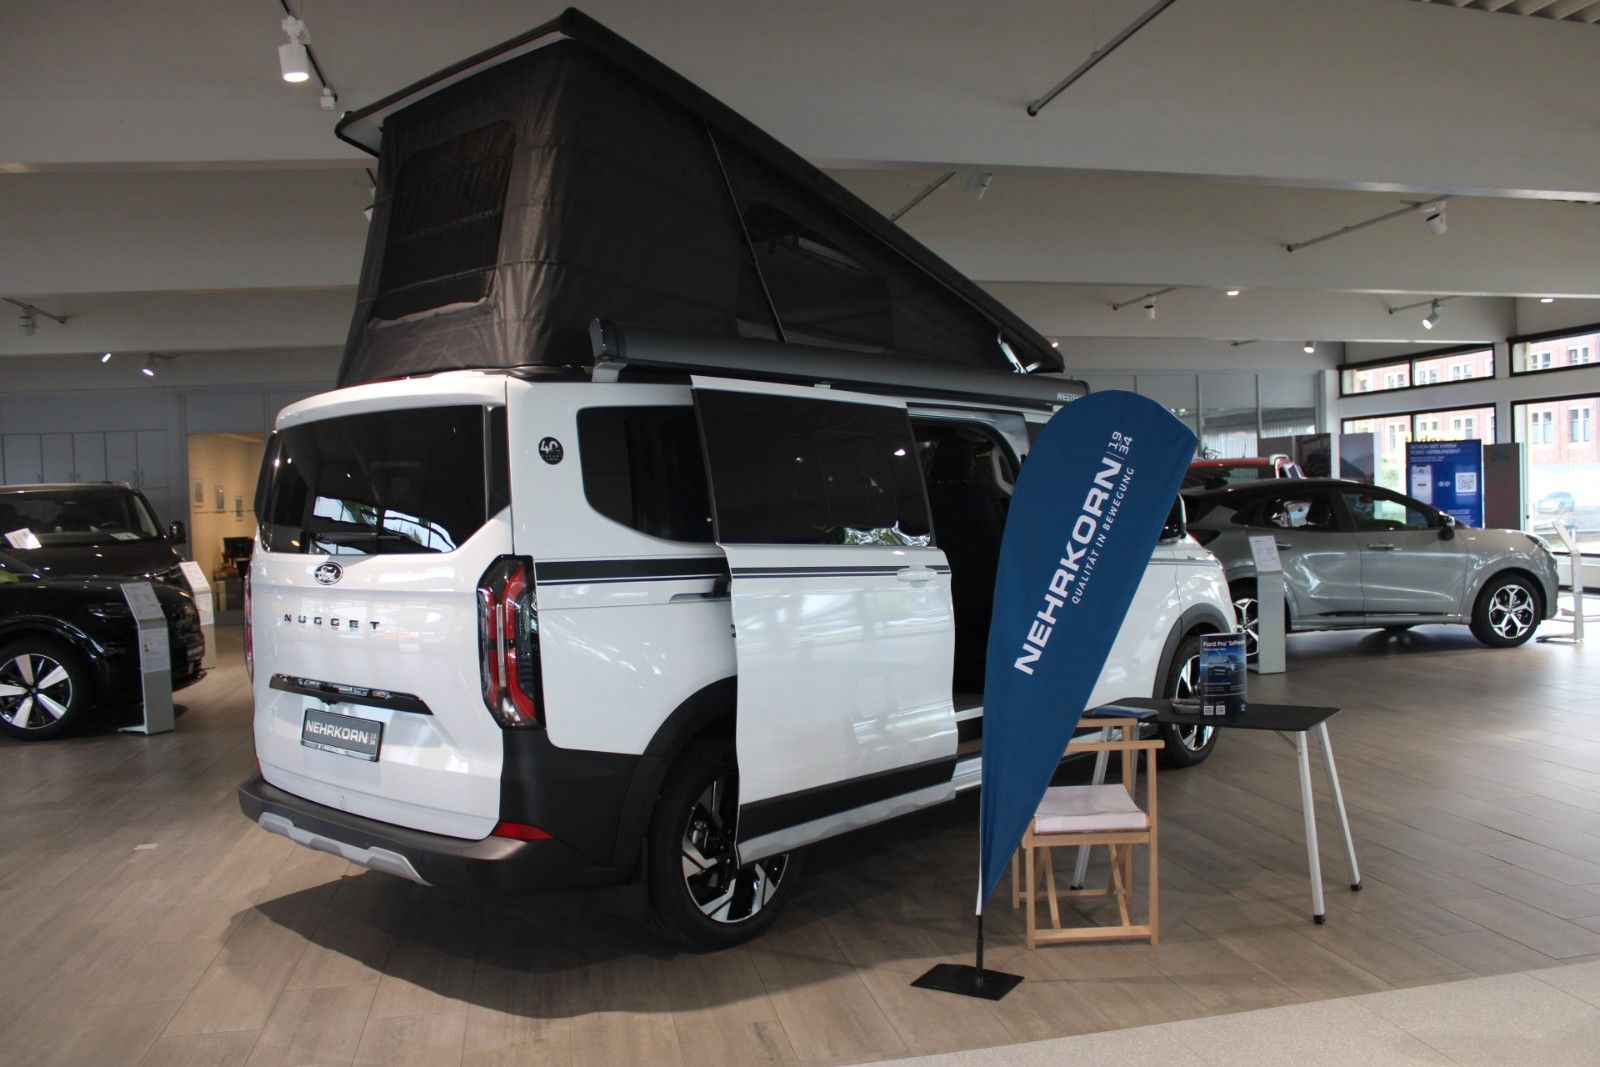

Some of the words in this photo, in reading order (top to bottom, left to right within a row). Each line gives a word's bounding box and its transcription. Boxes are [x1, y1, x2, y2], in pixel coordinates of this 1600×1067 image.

[1119, 436, 1133, 455] 34
[1072, 550, 1098, 604] QUALITÄT
[1096, 534, 1106, 547] IN
[1103, 468, 1135, 531] BEWEGUNG
[1014, 457, 1121, 675] NEHRKORN
[1108, 431, 1122, 450] 19
[283, 614, 381, 630] NUGGET
[305, 720, 368, 744] NEHRKORN
